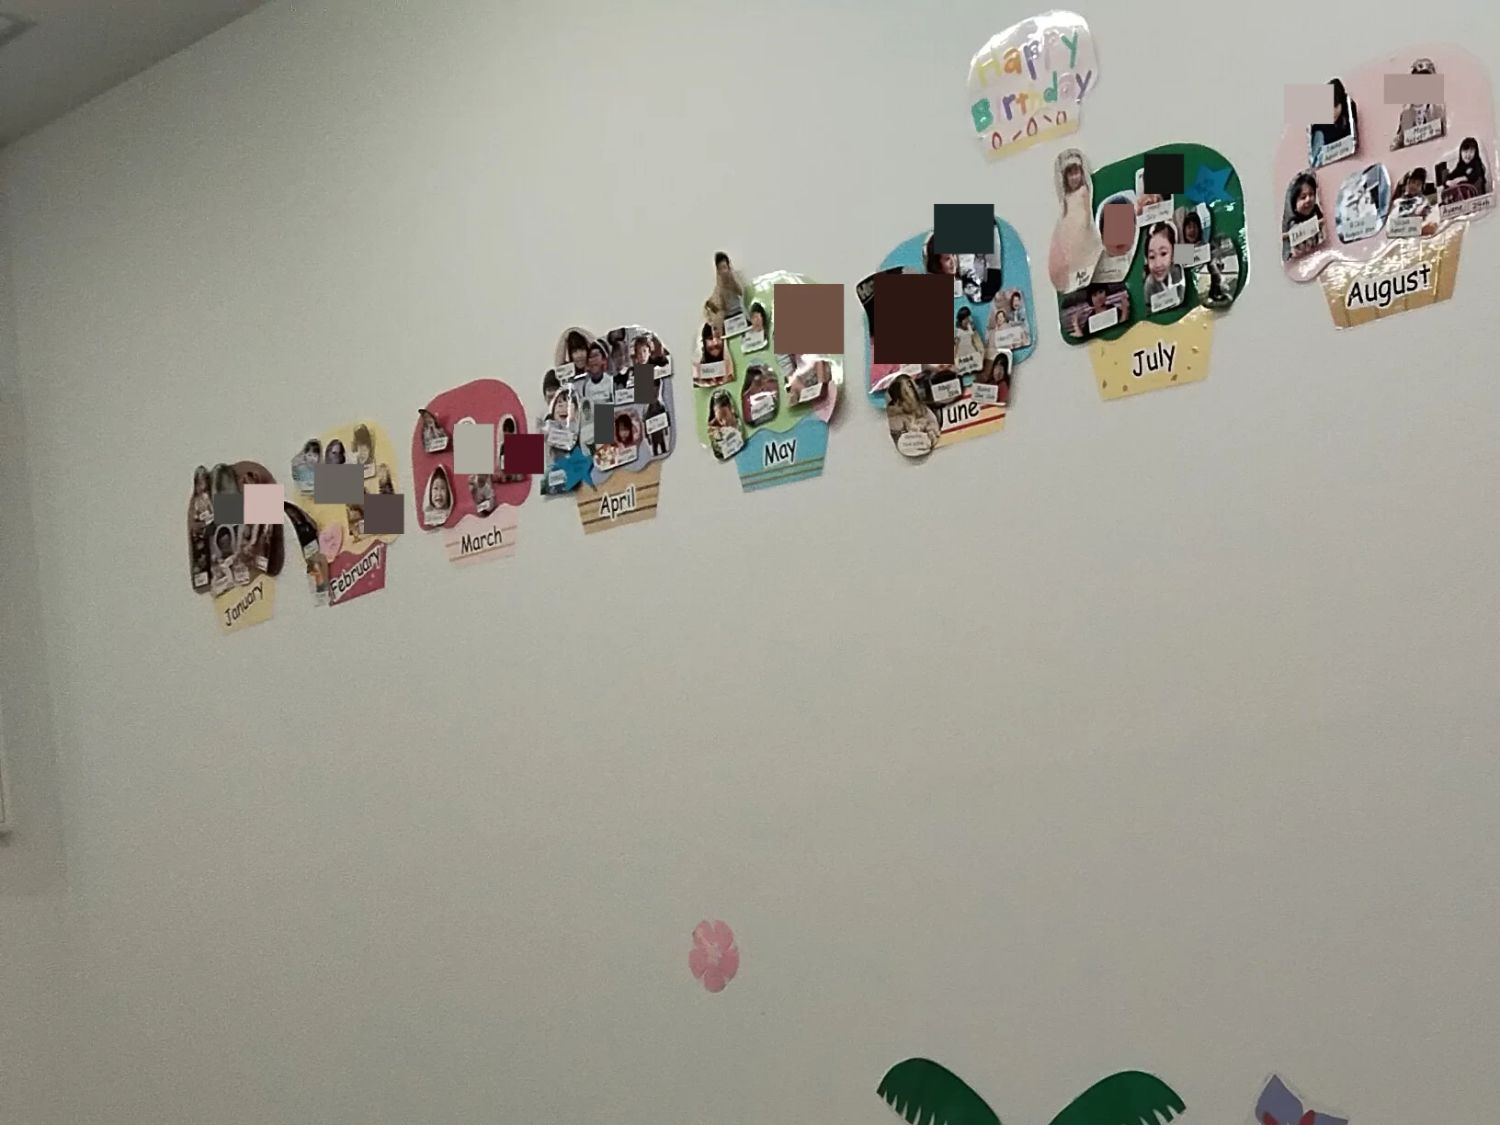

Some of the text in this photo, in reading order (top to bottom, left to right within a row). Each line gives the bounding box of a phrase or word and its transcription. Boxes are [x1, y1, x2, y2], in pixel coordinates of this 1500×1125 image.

[1347, 263, 1431, 307] August
[1132, 342, 1176, 378] July
[764, 439, 797, 466] May
[600, 488, 636, 518] April
[460, 525, 503, 554] March
[329, 547, 381, 599] February
[224, 581, 265, 627] January
